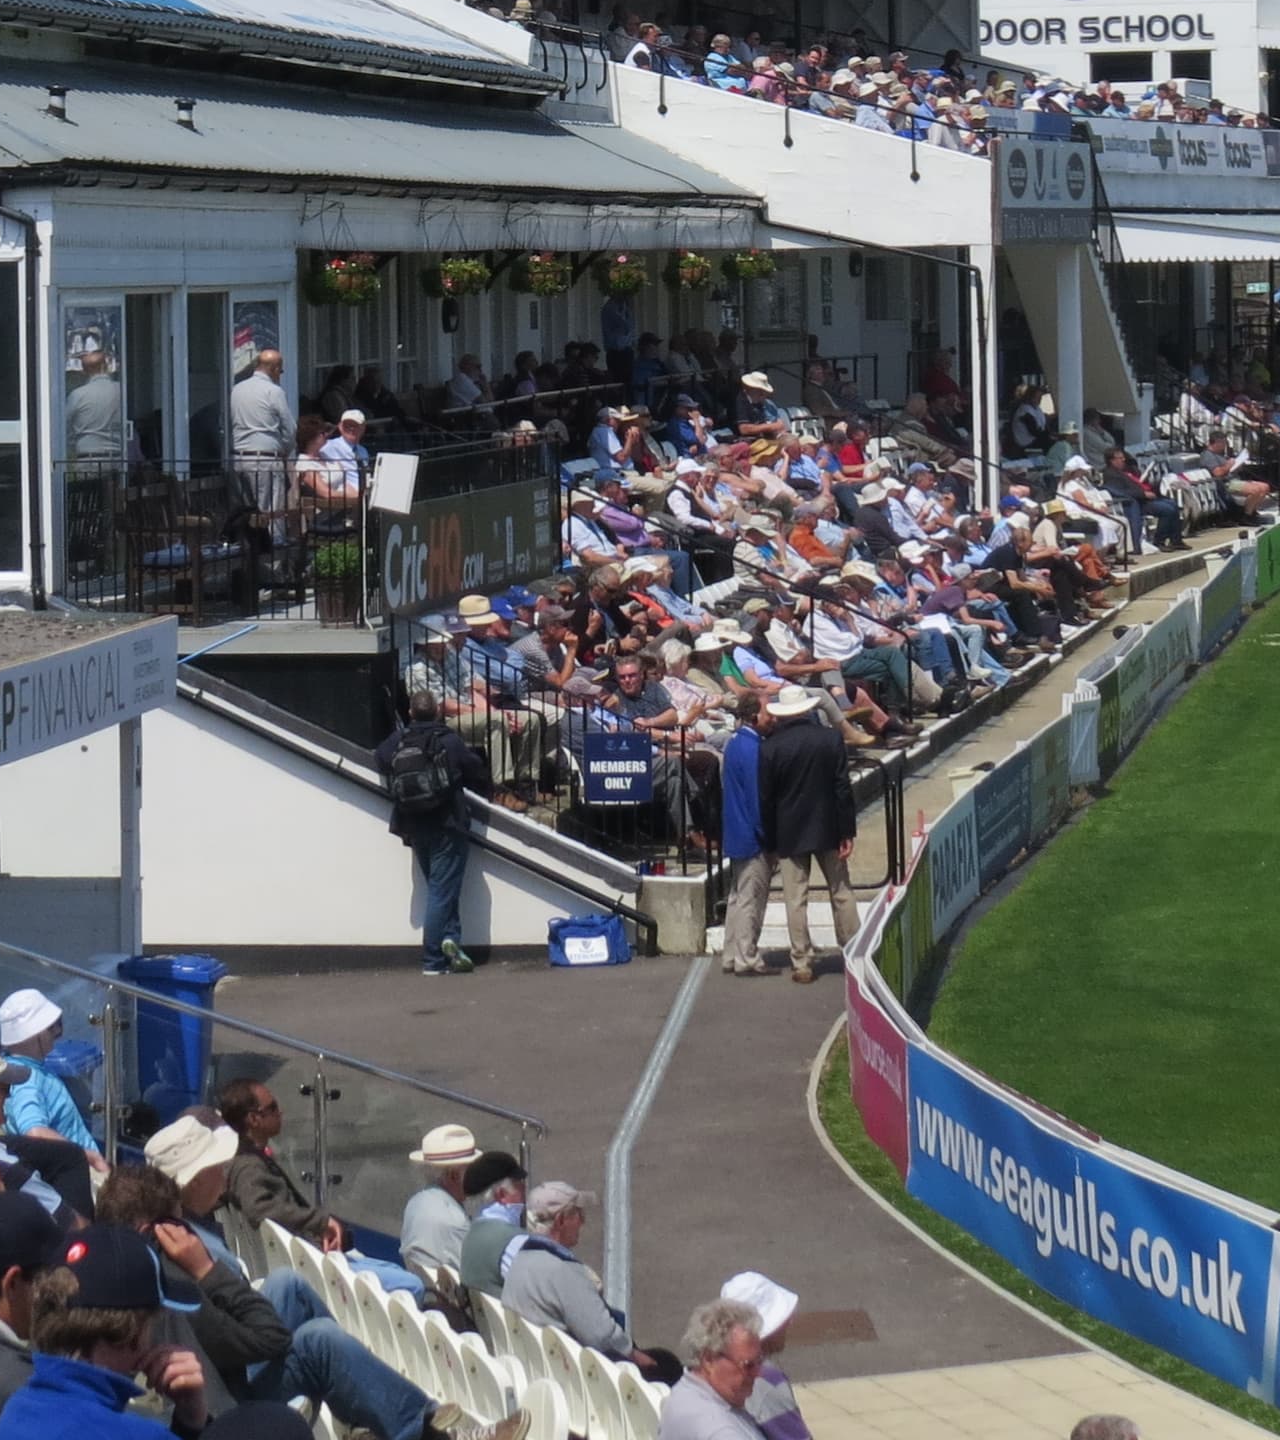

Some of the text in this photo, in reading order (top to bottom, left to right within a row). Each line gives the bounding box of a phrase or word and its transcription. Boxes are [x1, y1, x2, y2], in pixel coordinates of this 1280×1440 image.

[1079, 13, 1215, 44] SCHOOL
[590, 760, 647, 774] MEMBERS
[604, 776, 633, 791] ONLY
[915, 1096, 1247, 1334] www.seagulls.co.uk
